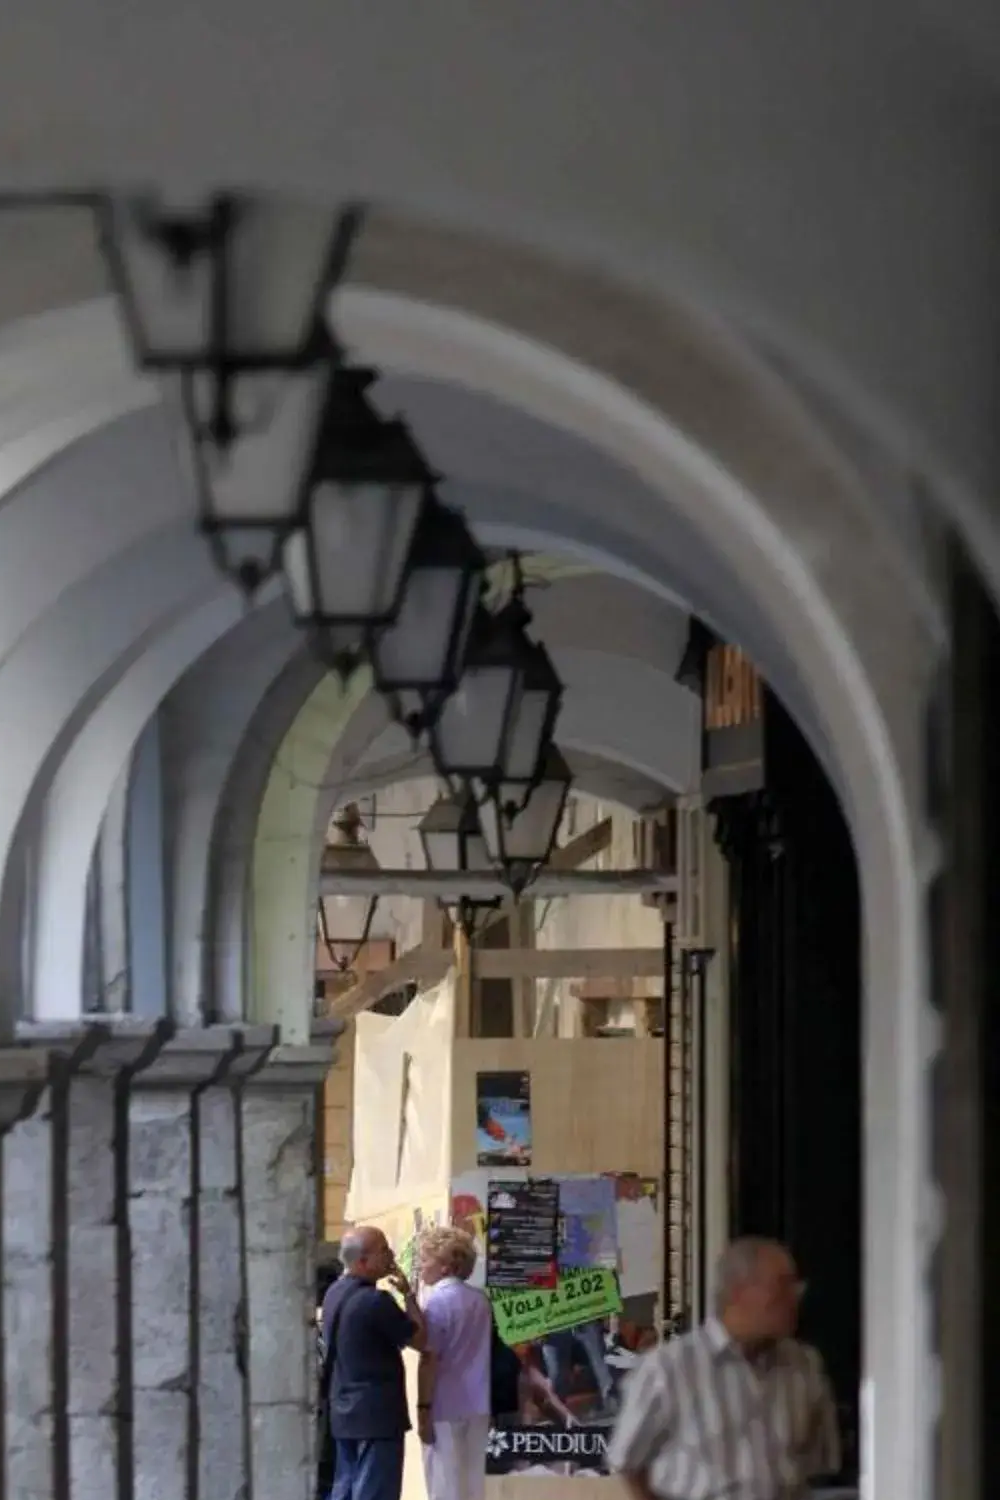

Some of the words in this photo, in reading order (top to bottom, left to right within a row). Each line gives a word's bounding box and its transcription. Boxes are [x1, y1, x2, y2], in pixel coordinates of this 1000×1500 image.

[502, 1296, 543, 1317] VOLA
[549, 1291, 560, 1304] A
[564, 1273, 605, 1300] 2.02
